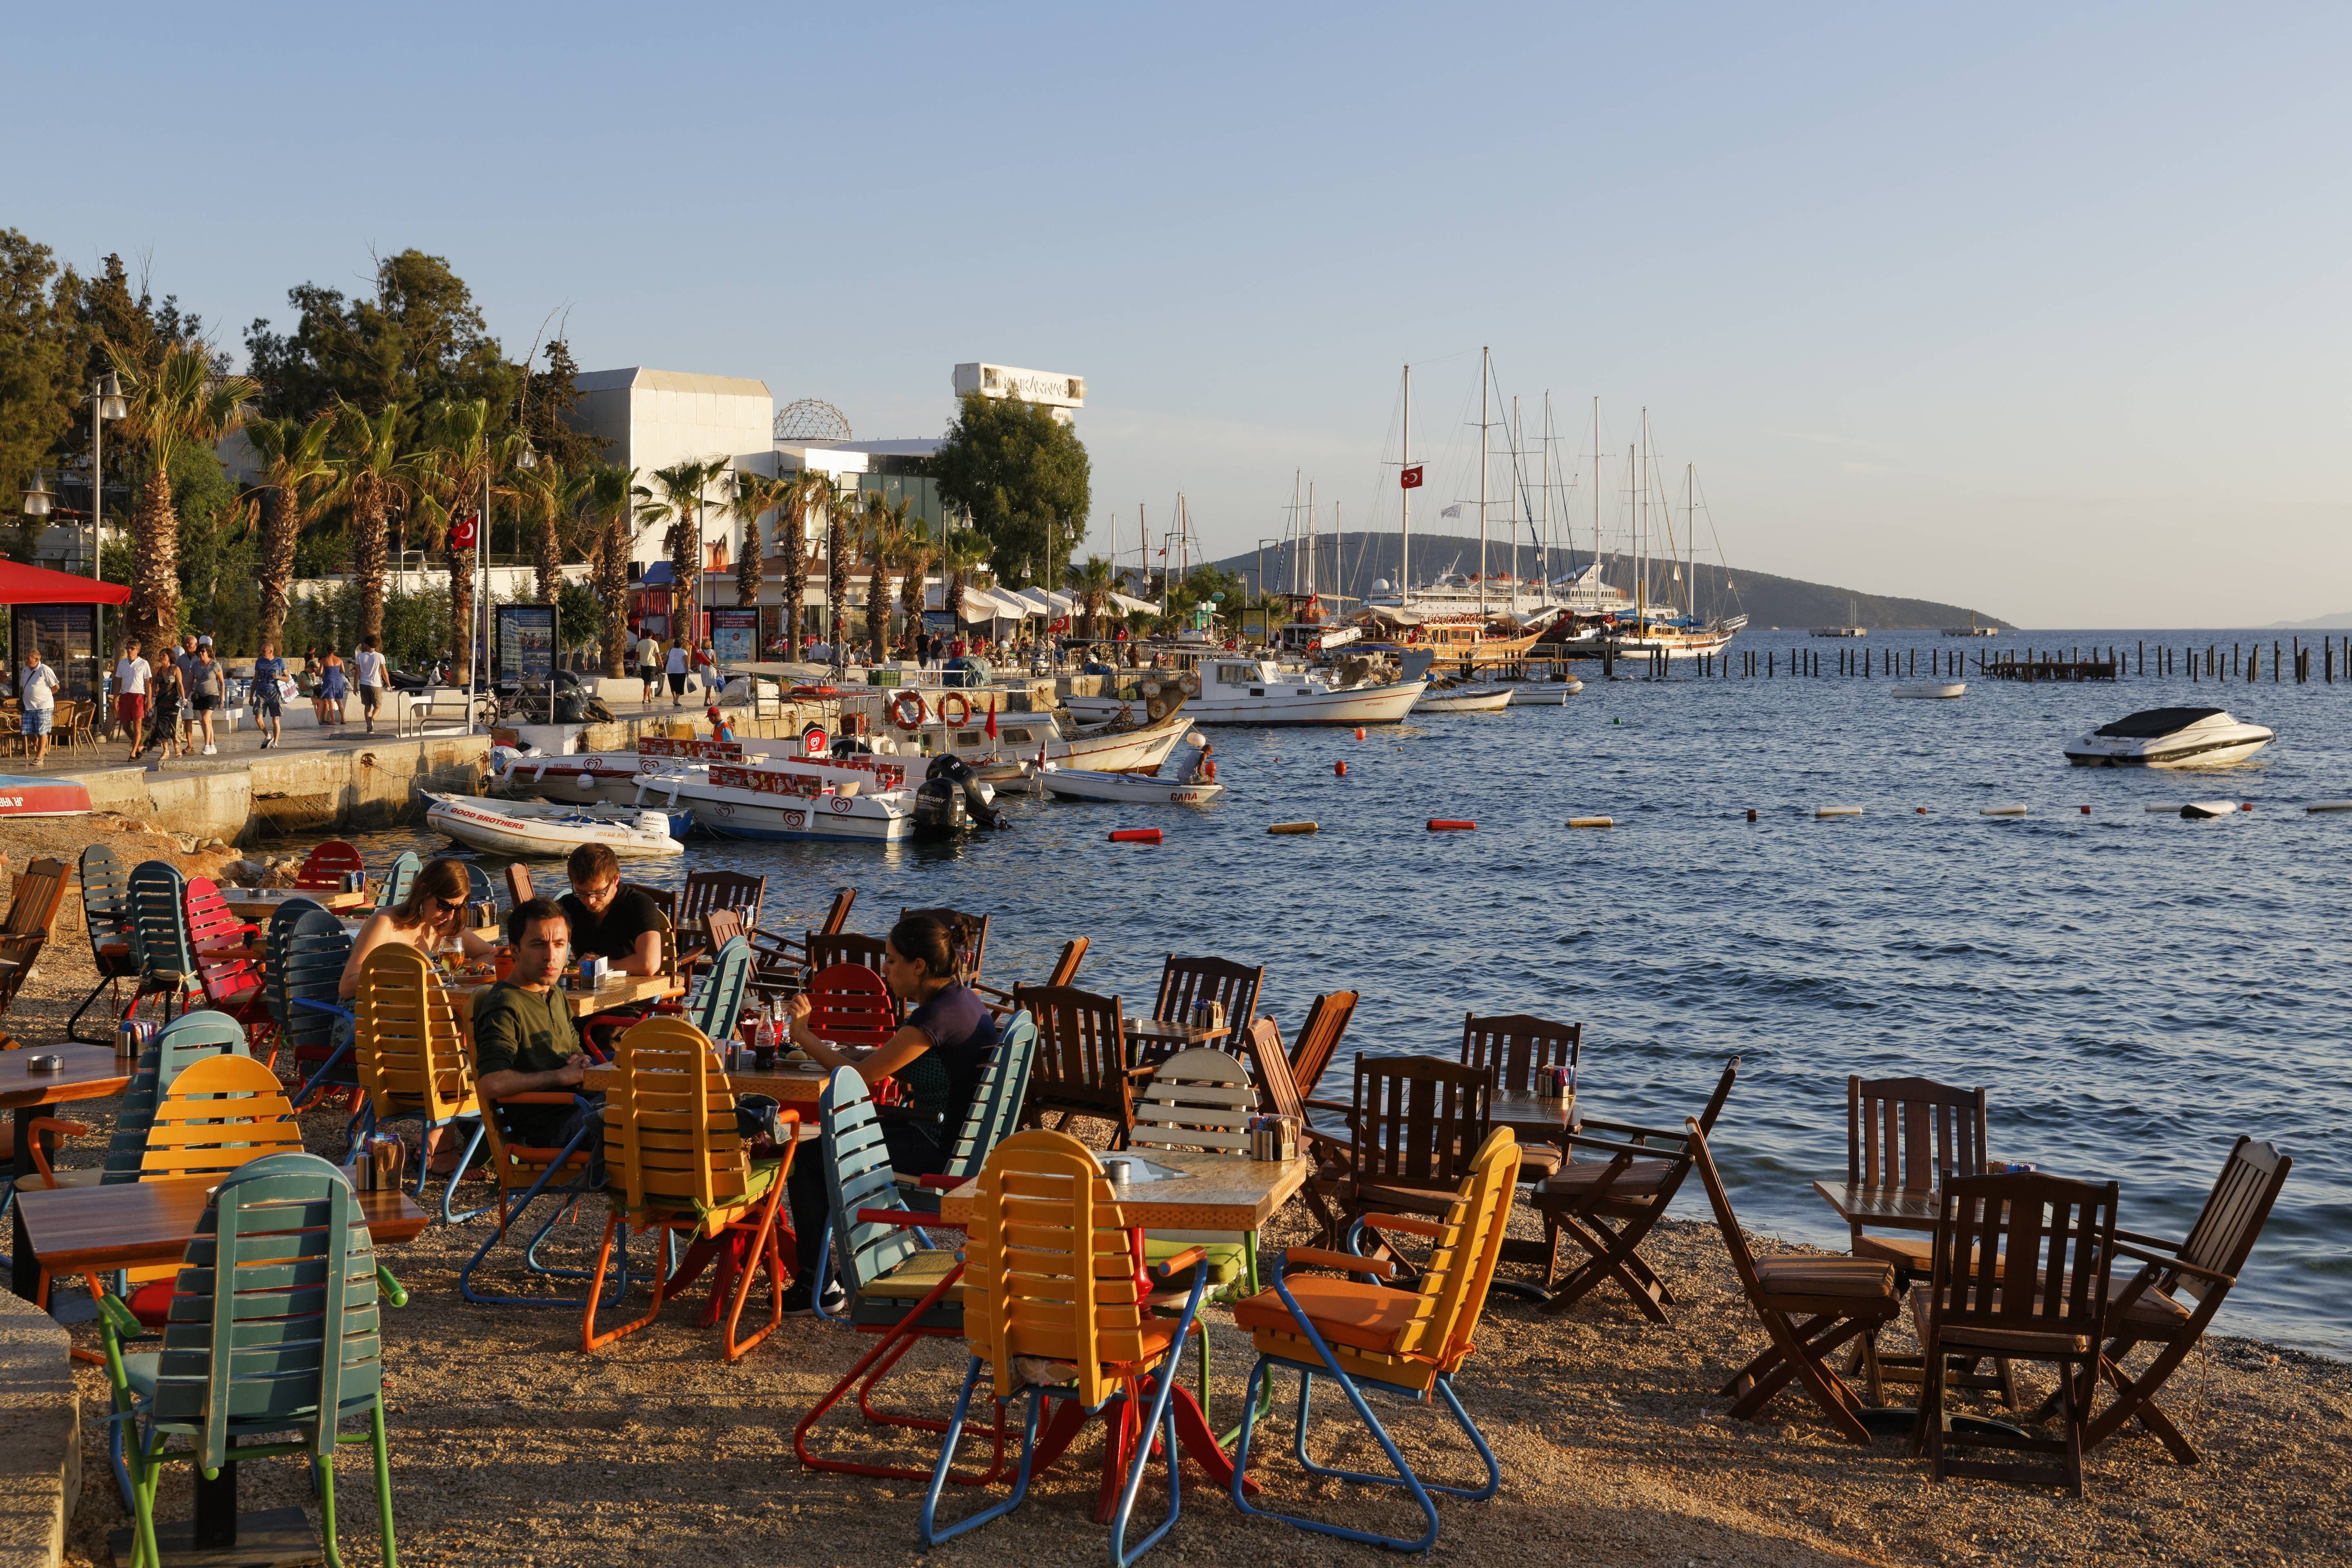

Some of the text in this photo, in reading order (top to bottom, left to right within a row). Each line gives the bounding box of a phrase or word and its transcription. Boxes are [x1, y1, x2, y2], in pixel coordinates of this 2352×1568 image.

[951, 762, 960, 770] 115
[918, 793, 946, 804] MERCURY
[450, 807, 525, 830] GOOD BROTHERS
